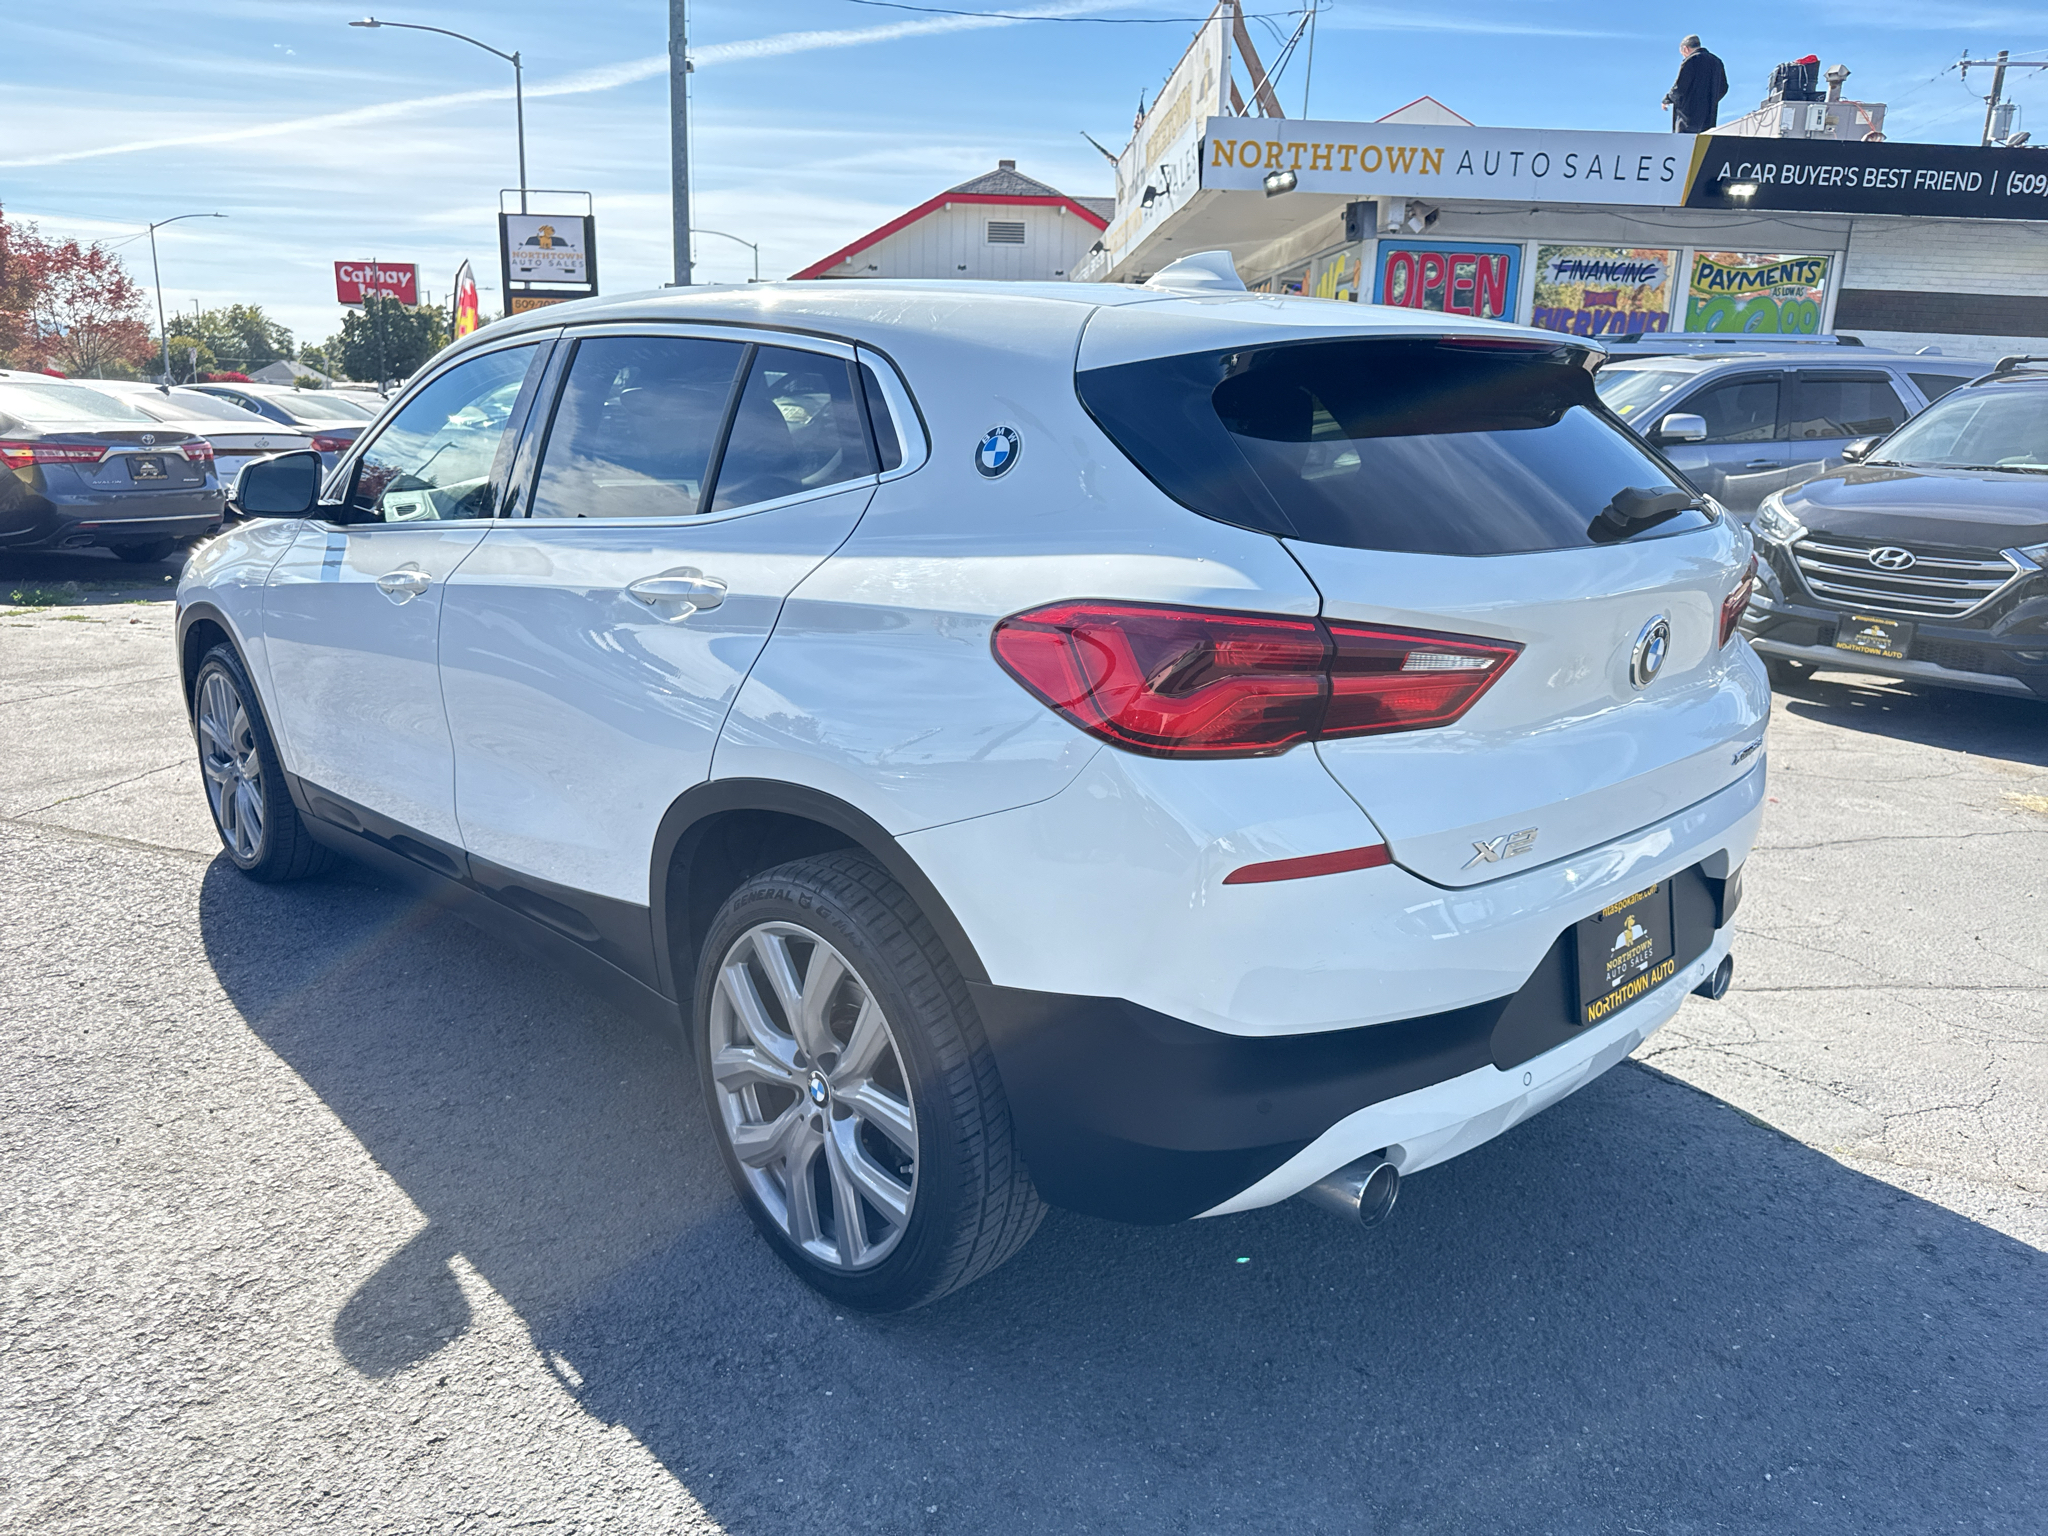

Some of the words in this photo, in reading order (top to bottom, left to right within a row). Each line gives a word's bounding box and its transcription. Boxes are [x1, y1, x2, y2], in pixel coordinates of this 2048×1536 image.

[1211, 139, 1445, 175] NORTHTOWN
[1456, 149, 1550, 178] AUTO
[1563, 152, 1677, 182] SALES
[1717, 162, 1731, 181] A
[1737, 163, 1776, 184] CAR
[1780, 164, 1859, 187] BUYER'S
[1863, 167, 1911, 188] BEST
[1914, 170, 1982, 192] FRIEND
[511, 251, 584, 260] NORTHTOWN
[511, 259, 542, 267] AUTO
[548, 260, 584, 268] SALES
[340, 265, 412, 288] Cathay
[1384, 250, 1509, 317] OPEN
[1554, 259, 1657, 283] FINANCING
[1696, 260, 1821, 291] PAYMENTS
[981, 427, 1017, 444] BMW
[1836, 642, 1881, 656] NORTHTOWN
[1882, 650, 1903, 659] AUTO
[1461, 827, 1539, 870] X2
[733, 888, 793, 912] GENERAL
[1606, 938, 1653, 972] NORTHTOWN
[1606, 964, 1627, 981] AUTO
[1630, 948, 1653, 968] SALES
[1588, 974, 1649, 1022] NORTHTOWN
[1651, 959, 1675, 985] AUTO
